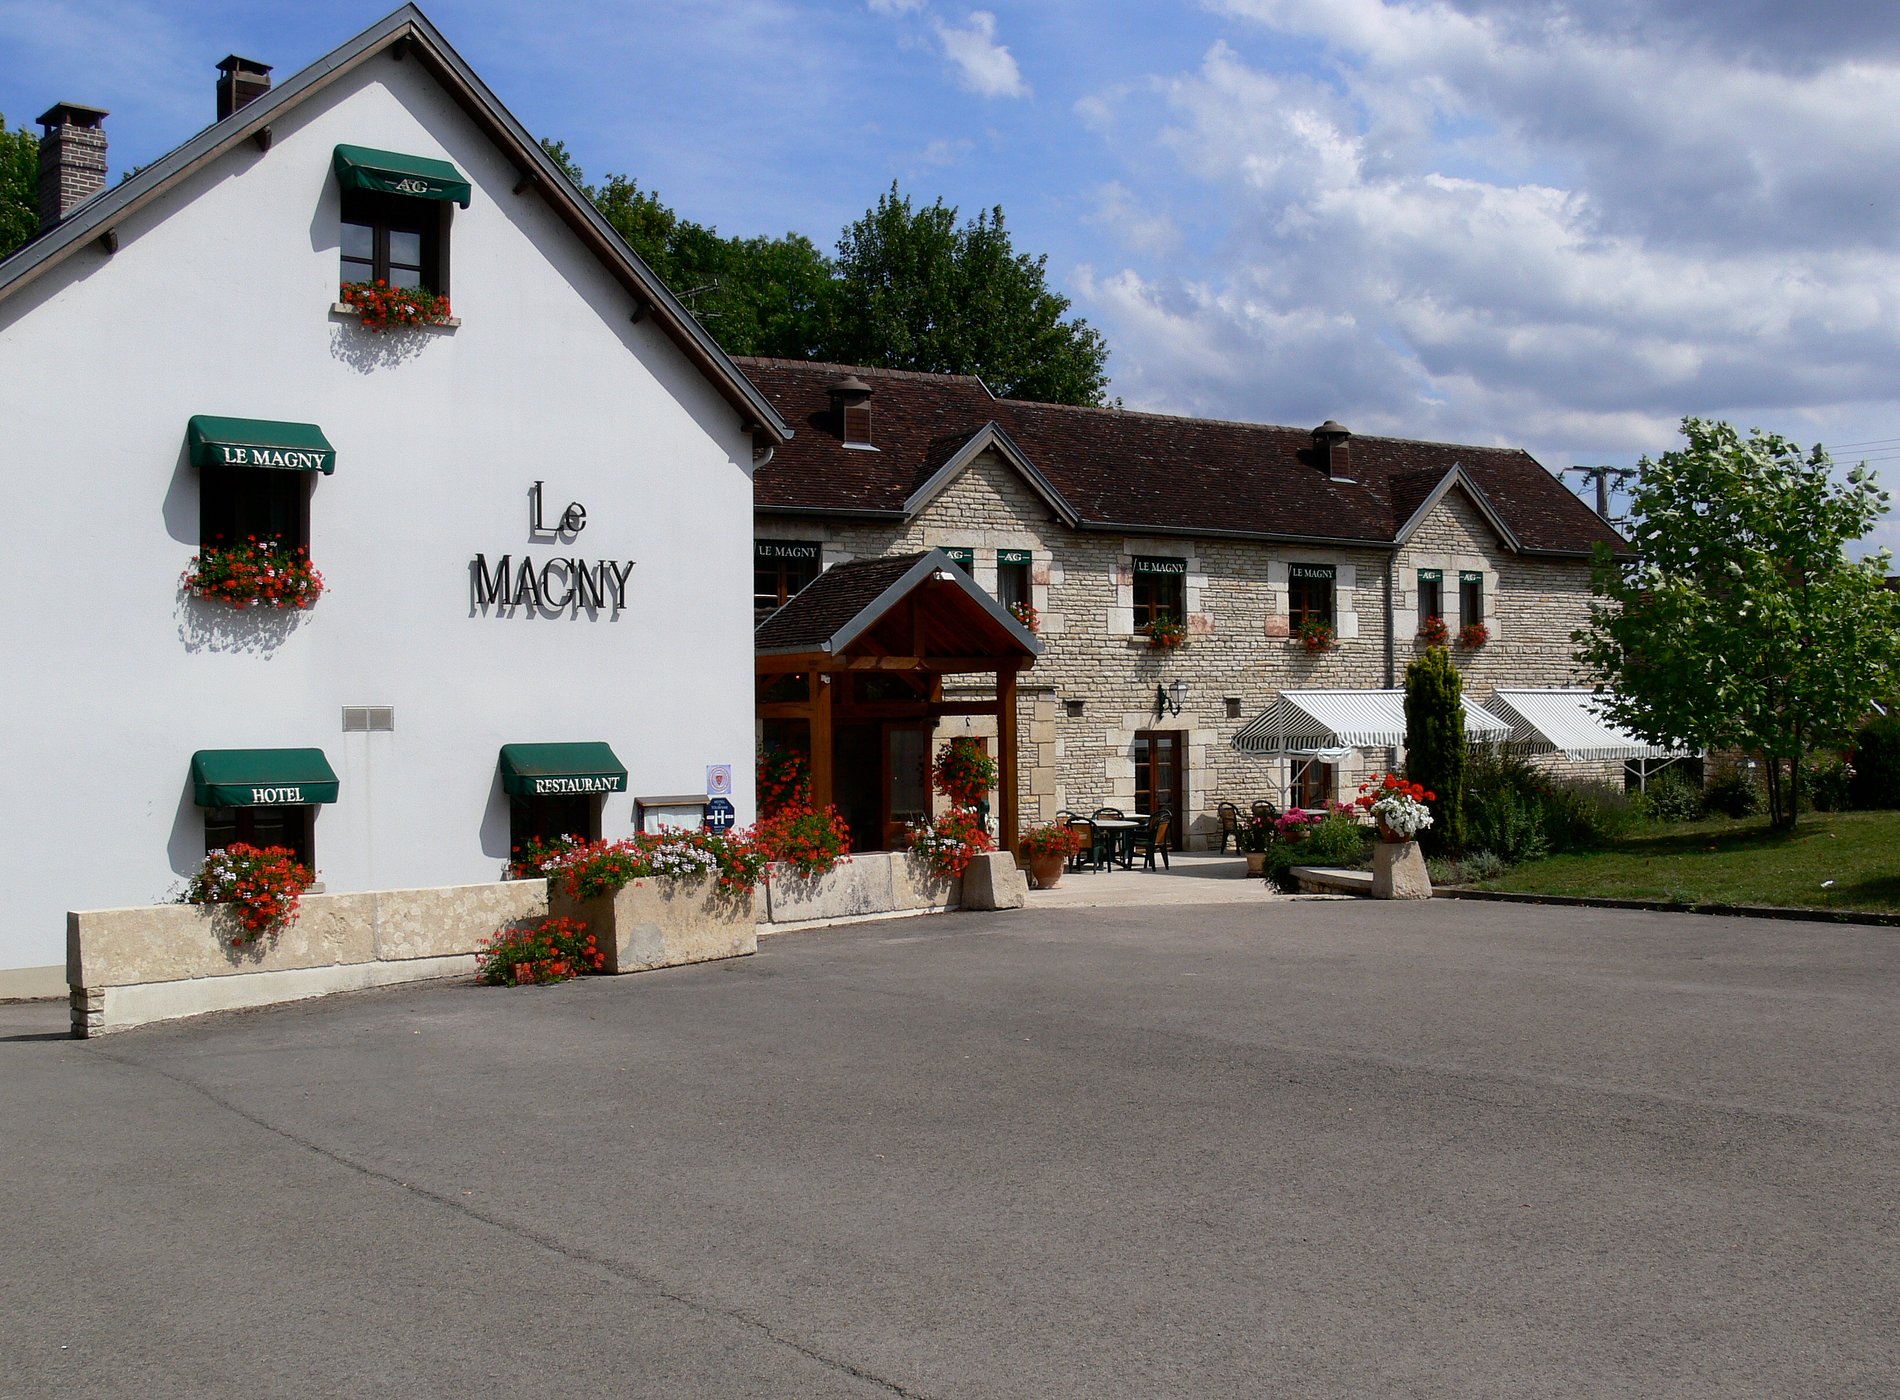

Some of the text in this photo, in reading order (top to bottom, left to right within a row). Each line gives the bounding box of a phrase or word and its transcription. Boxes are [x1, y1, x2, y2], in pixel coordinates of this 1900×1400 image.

[222, 447, 326, 470] LE MAGNY
[533, 480, 587, 532] Le
[758, 545, 817, 558] LE MAGNY
[1138, 562, 1184, 572] LE MAGNY
[1293, 568, 1333, 578] LE MAGNY
[475, 553, 637, 610] MAGNY
[535, 776, 620, 793] RESTAURANT
[251, 787, 305, 803] HOTEL
[714, 809, 725, 825] H
